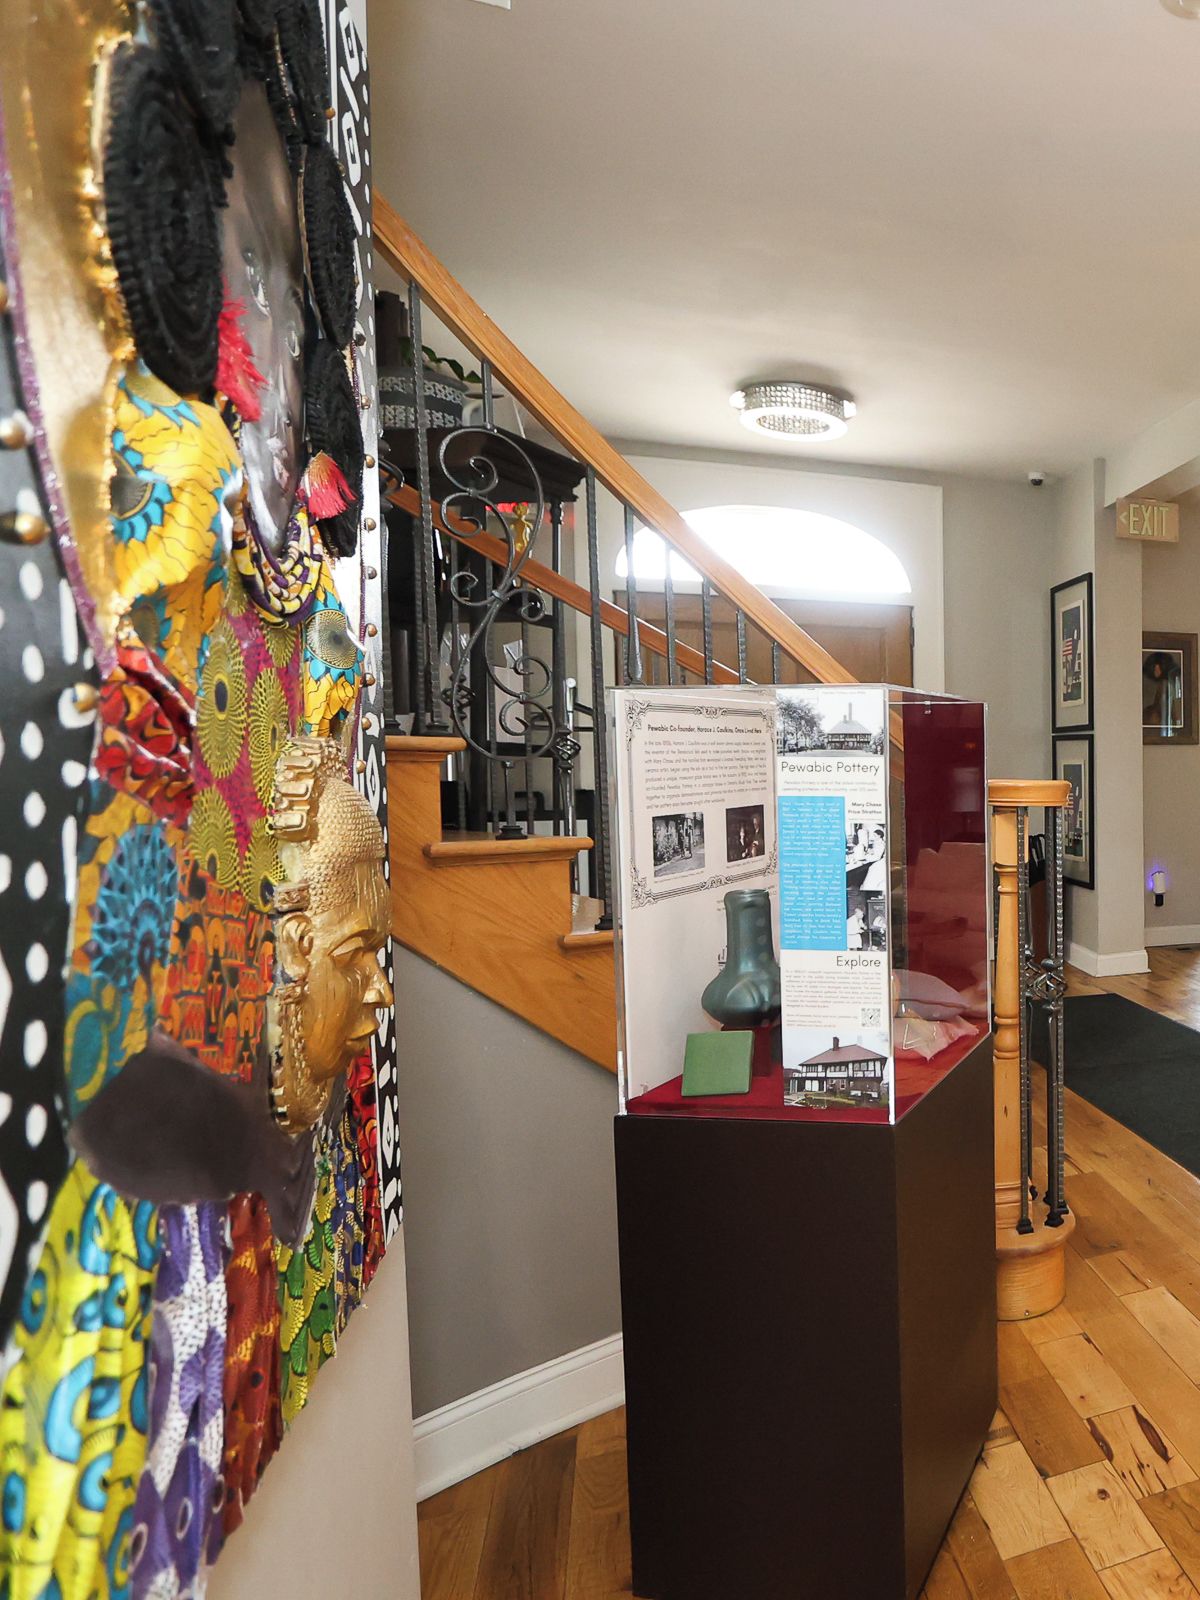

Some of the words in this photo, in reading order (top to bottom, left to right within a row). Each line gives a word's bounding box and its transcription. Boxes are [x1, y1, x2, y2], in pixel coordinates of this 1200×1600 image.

[1129, 503, 1169, 537] EXIT
[647, 724, 669, 732] Pewabic
[696, 725, 712, 733] Horace
[780, 761, 833, 773] Pewabic
[836, 761, 880, 776] Pottery
[836, 954, 881, 970] Explore
